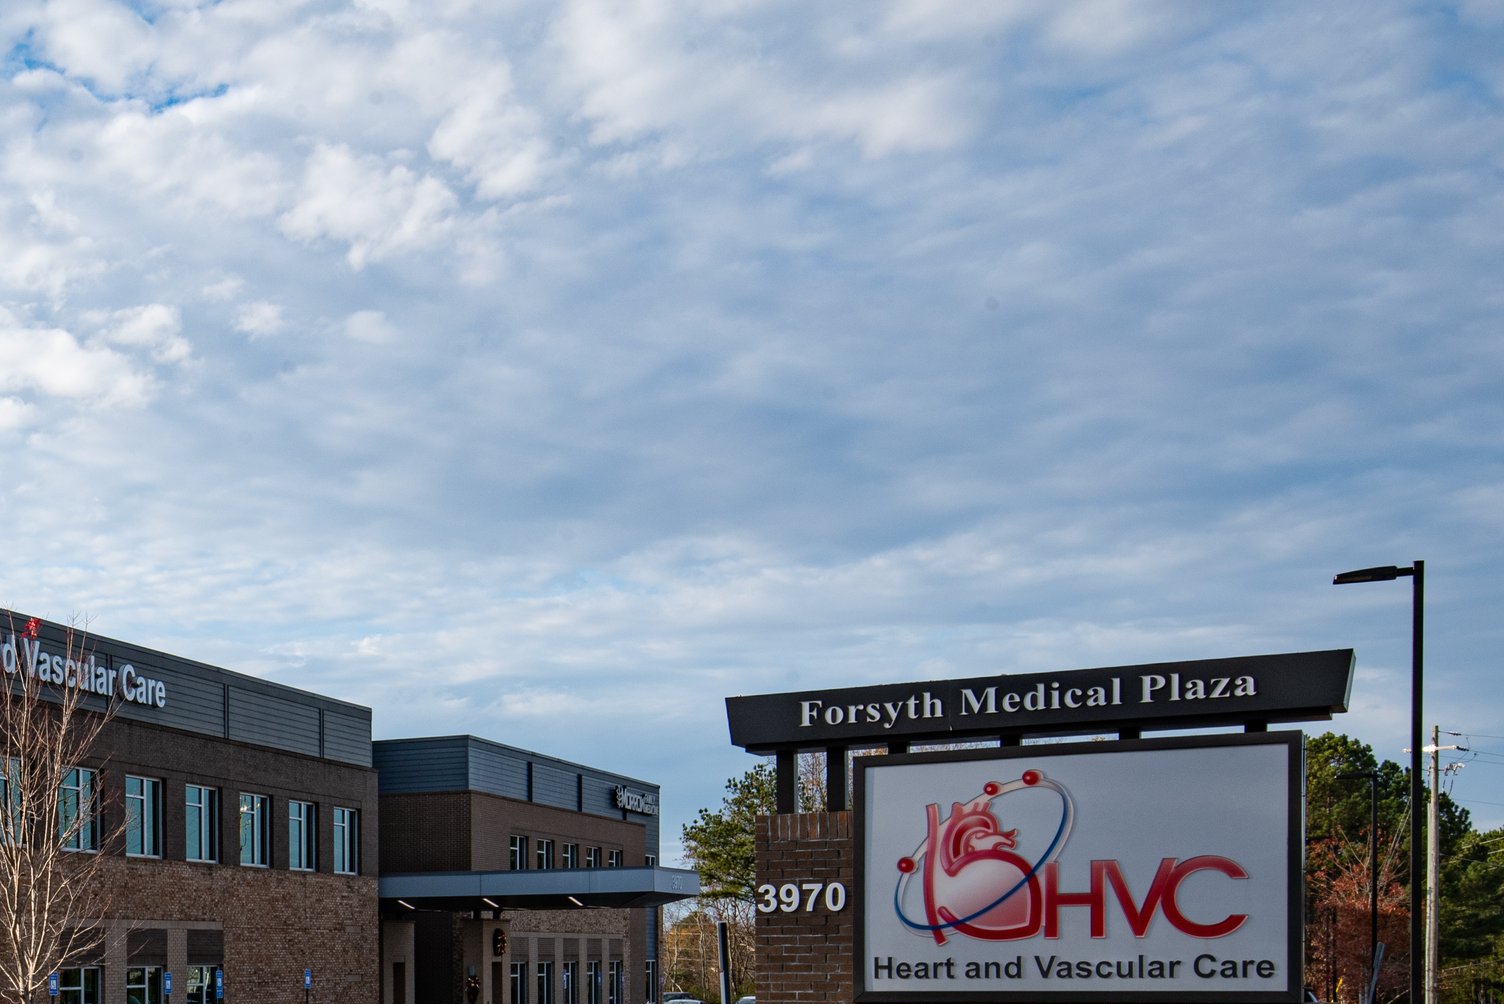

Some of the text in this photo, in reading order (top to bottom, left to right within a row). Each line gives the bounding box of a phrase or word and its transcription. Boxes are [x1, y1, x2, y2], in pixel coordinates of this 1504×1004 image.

[22, 637, 116, 697] Vascular
[121, 663, 166, 708] Care
[799, 672, 1257, 730] Forsyth Medical Plaza
[757, 881, 846, 913] 3970
[1044, 855, 1249, 940] HVC
[873, 953, 1276, 980] Heart and Vascular Care
